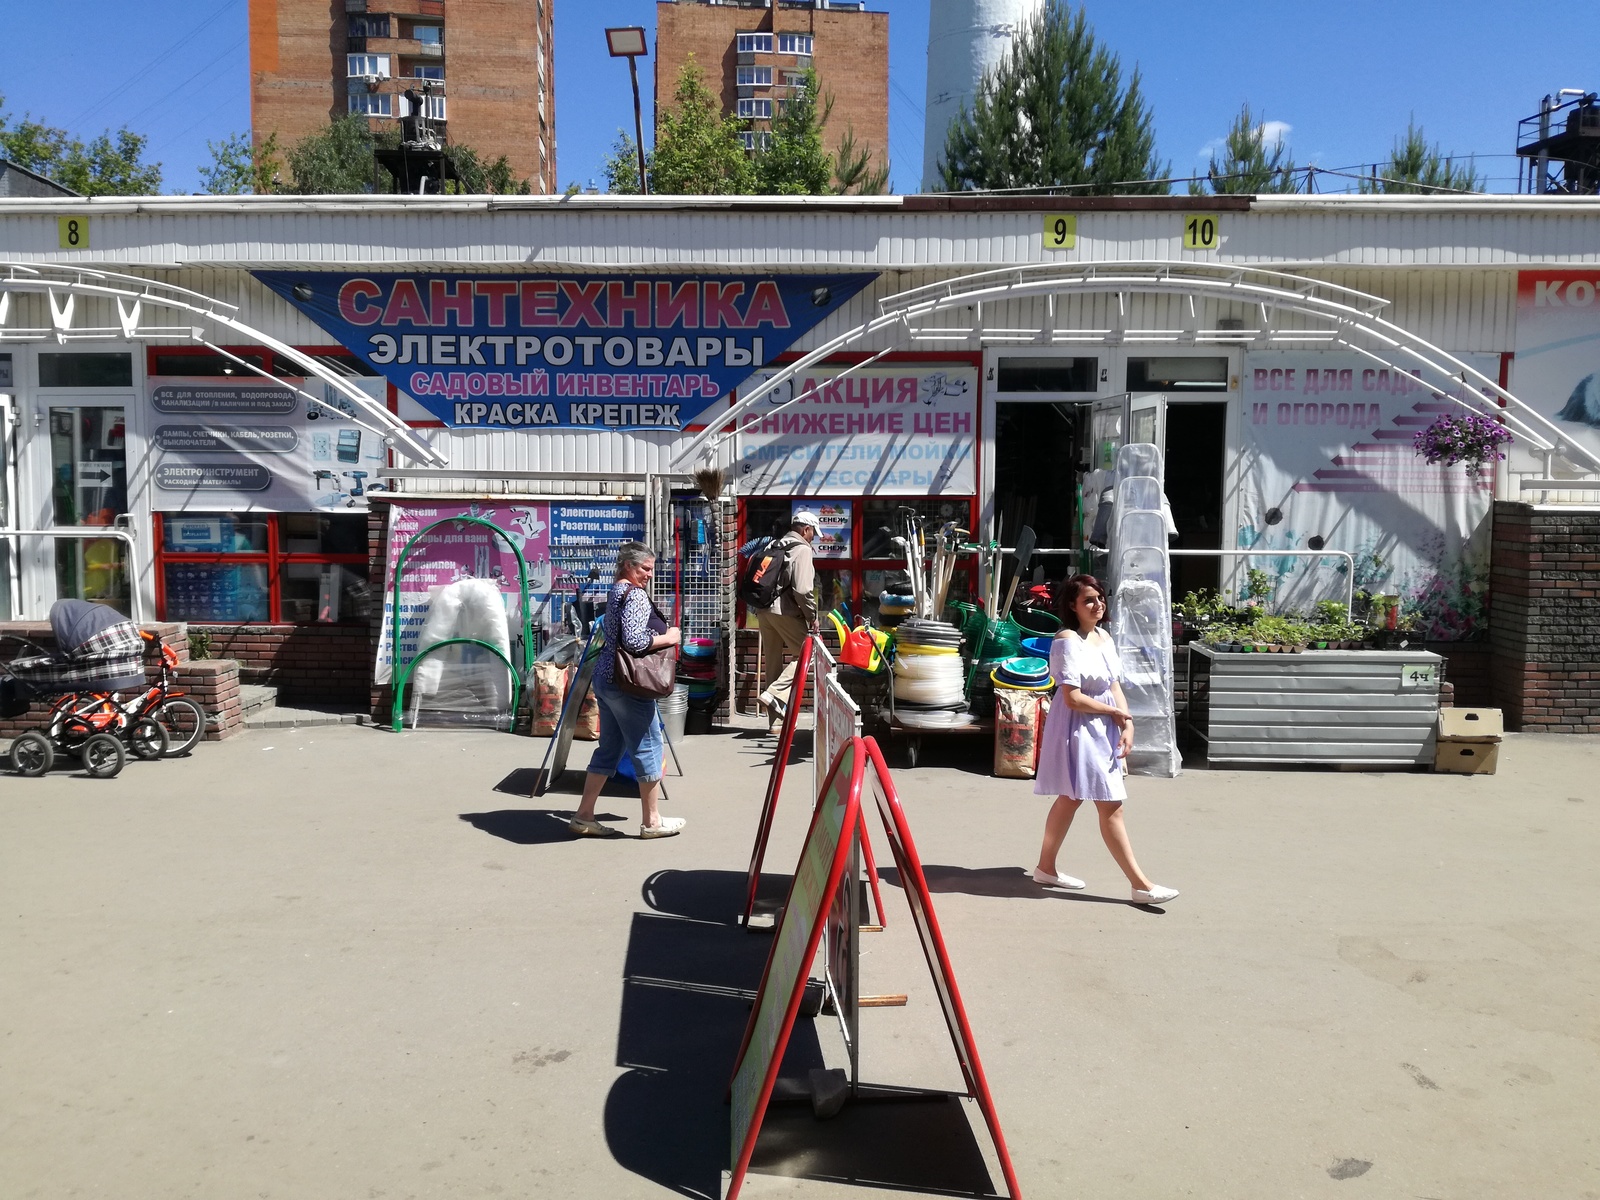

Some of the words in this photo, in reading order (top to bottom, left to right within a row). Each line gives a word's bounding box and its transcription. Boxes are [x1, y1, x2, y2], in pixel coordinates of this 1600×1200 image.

[68, 220, 79, 246] 8
[1054, 218, 1067, 245] 9
[1187, 219, 1214, 246] 10
[338, 278, 791, 328] САНТЕХНИКА
[1535, 280, 1600, 307] КО
[368, 334, 763, 366] ЭЛЕКТРОТОВАРЫ
[410, 369, 549, 398] САДОВЫЙ
[557, 373, 720, 398] ИНВЕНТАРЬ
[799, 377, 918, 408] АКЦИЯ
[1253, 368, 1296, 391] ВСЕ
[1303, 368, 1353, 395] ДЛЯ
[1361, 368, 1423, 395] САДА
[177, 391, 192, 399] ДЛЯ
[195, 391, 238, 399] ОТОПЛЕНИЯ,
[241, 392, 294, 400] ВОДОПРОВОДА,
[454, 403, 559, 425] КРАСКА
[570, 403, 680, 426] КРЕПЕЖ
[742, 412, 903, 434] СНИЖЕНИЕ
[914, 412, 971, 437] ЦЕН
[1252, 402, 1268, 425] И
[1277, 402, 1382, 429] ОГОРОДА
[162, 430, 191, 438] ЛАМПЫ,
[742, 445, 882, 461] СМЕСИТЕЛИ
[890, 440, 971, 460] МОЙКИ
[163, 467, 259, 477] ЭЛЕКТРОИНСТРУМЕНТ
[779, 470, 932, 486] АКСЕССУАРЫ
[560, 507, 635, 519] Электрокабель
[560, 521, 602, 531] Розетки,
[444, 534, 464, 544] для
[464, 534, 488, 543] ванн
[752, 555, 774, 583] FILA
